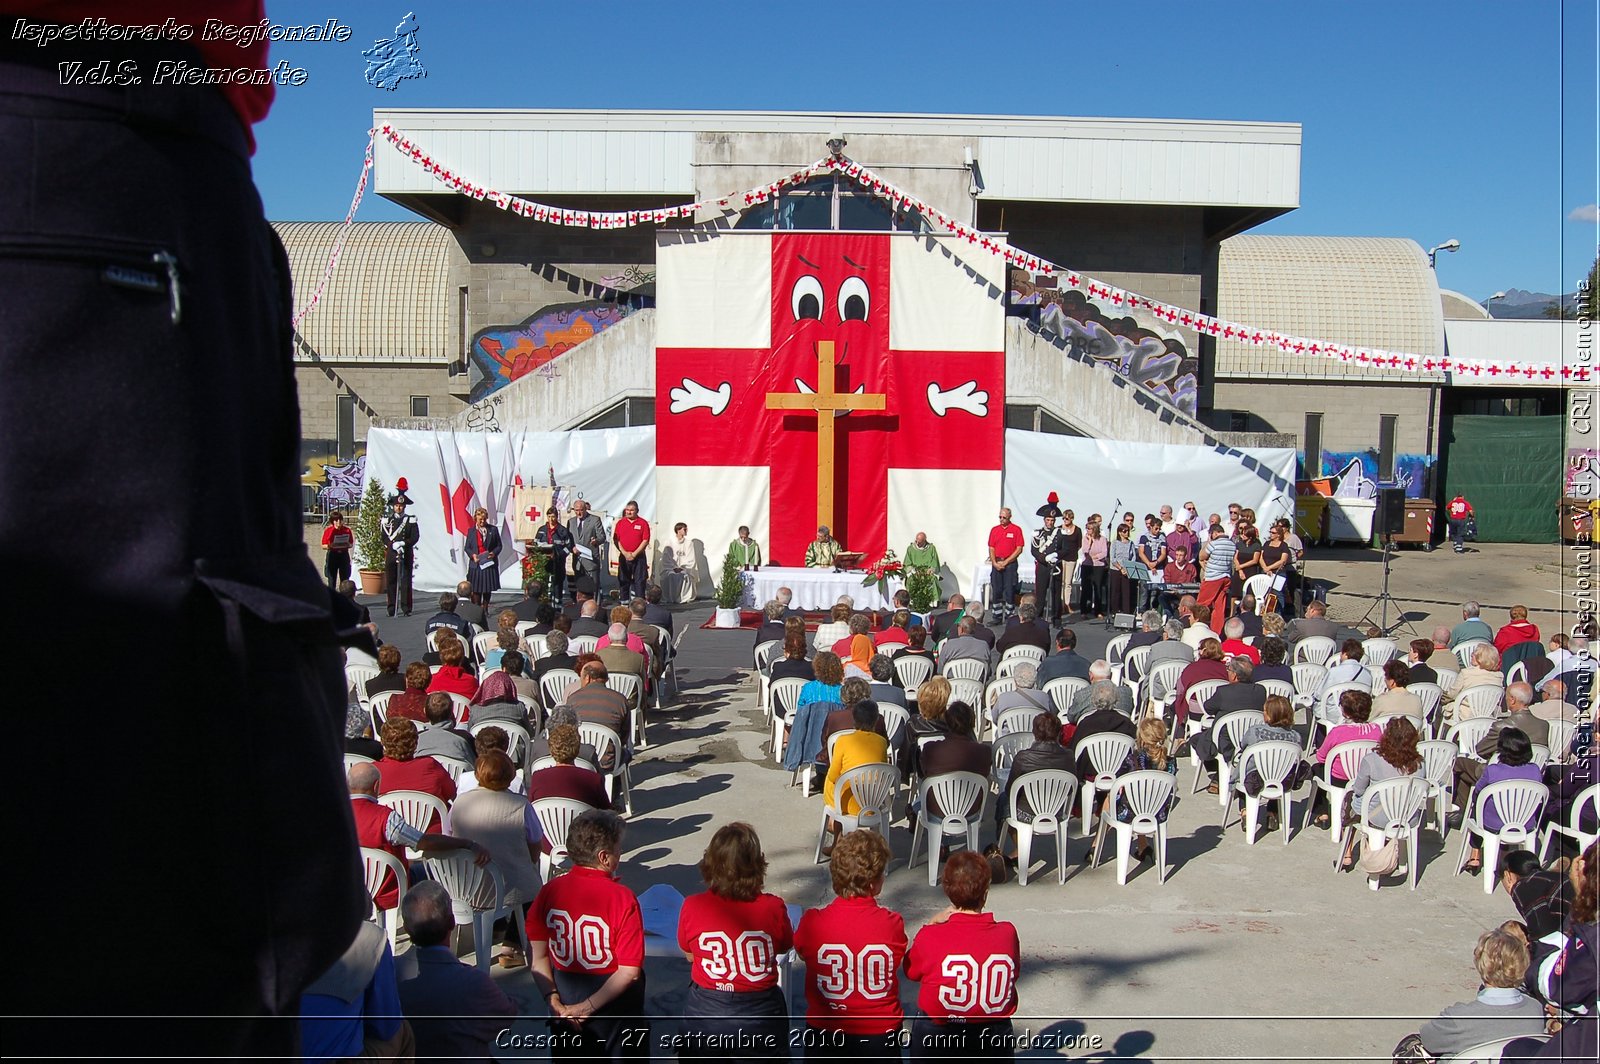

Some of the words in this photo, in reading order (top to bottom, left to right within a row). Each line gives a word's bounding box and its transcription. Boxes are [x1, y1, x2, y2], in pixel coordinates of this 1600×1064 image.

[547, 909, 613, 969] 30
[698, 931, 775, 982] 30
[817, 944, 894, 1000] 30
[938, 954, 1016, 1014] 30
